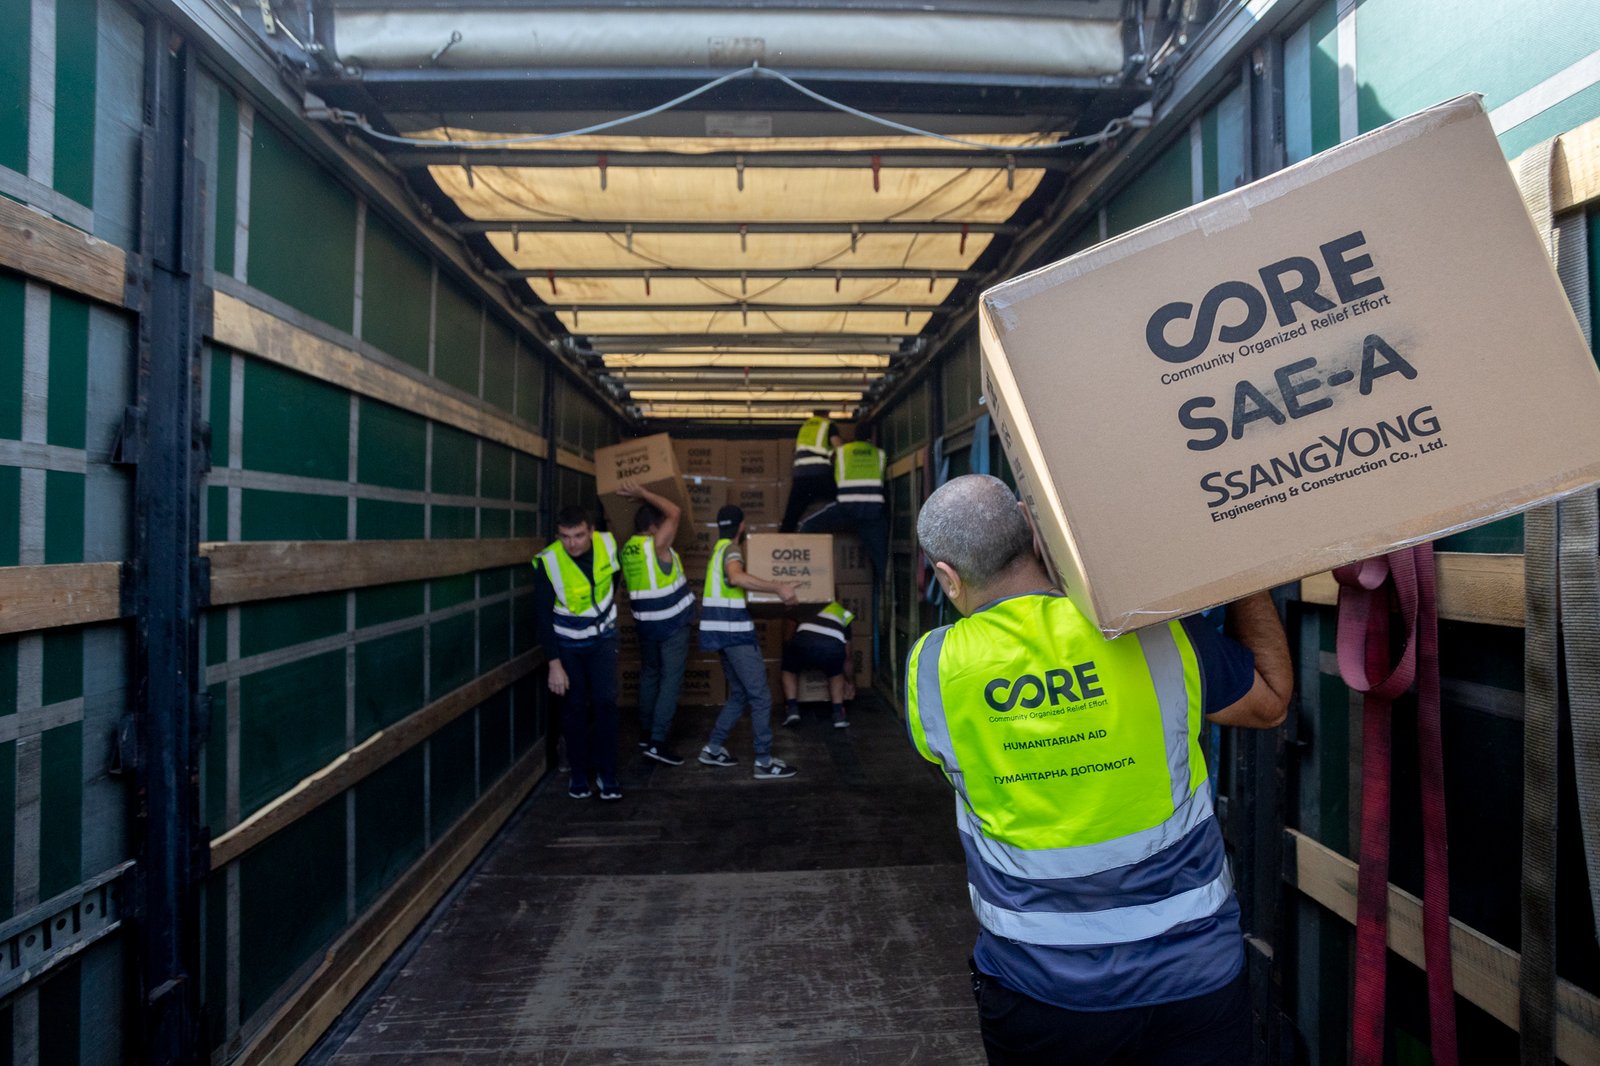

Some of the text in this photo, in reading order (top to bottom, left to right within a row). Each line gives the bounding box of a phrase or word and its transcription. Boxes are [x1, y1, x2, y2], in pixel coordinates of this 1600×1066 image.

[1146, 230, 1385, 363] CORE
[1161, 294, 1391, 385] Community Organized Relief Effort
[1178, 334, 1417, 451] SAE-A
[1200, 405, 1441, 508] SSANGYONG
[1210, 439, 1448, 523] Engineering & Construction Co., Ltd.
[772, 549, 810, 561] CORE
[772, 565, 811, 577] SAE-A
[984, 661, 1105, 712] CORE
[989, 699, 1108, 723] Community Organized Relief Effort
[1003, 729, 1107, 751] HUMANITARIAN AID
[994, 757, 1136, 785] ГУМАНІТАРНА ДОПОМОГА
